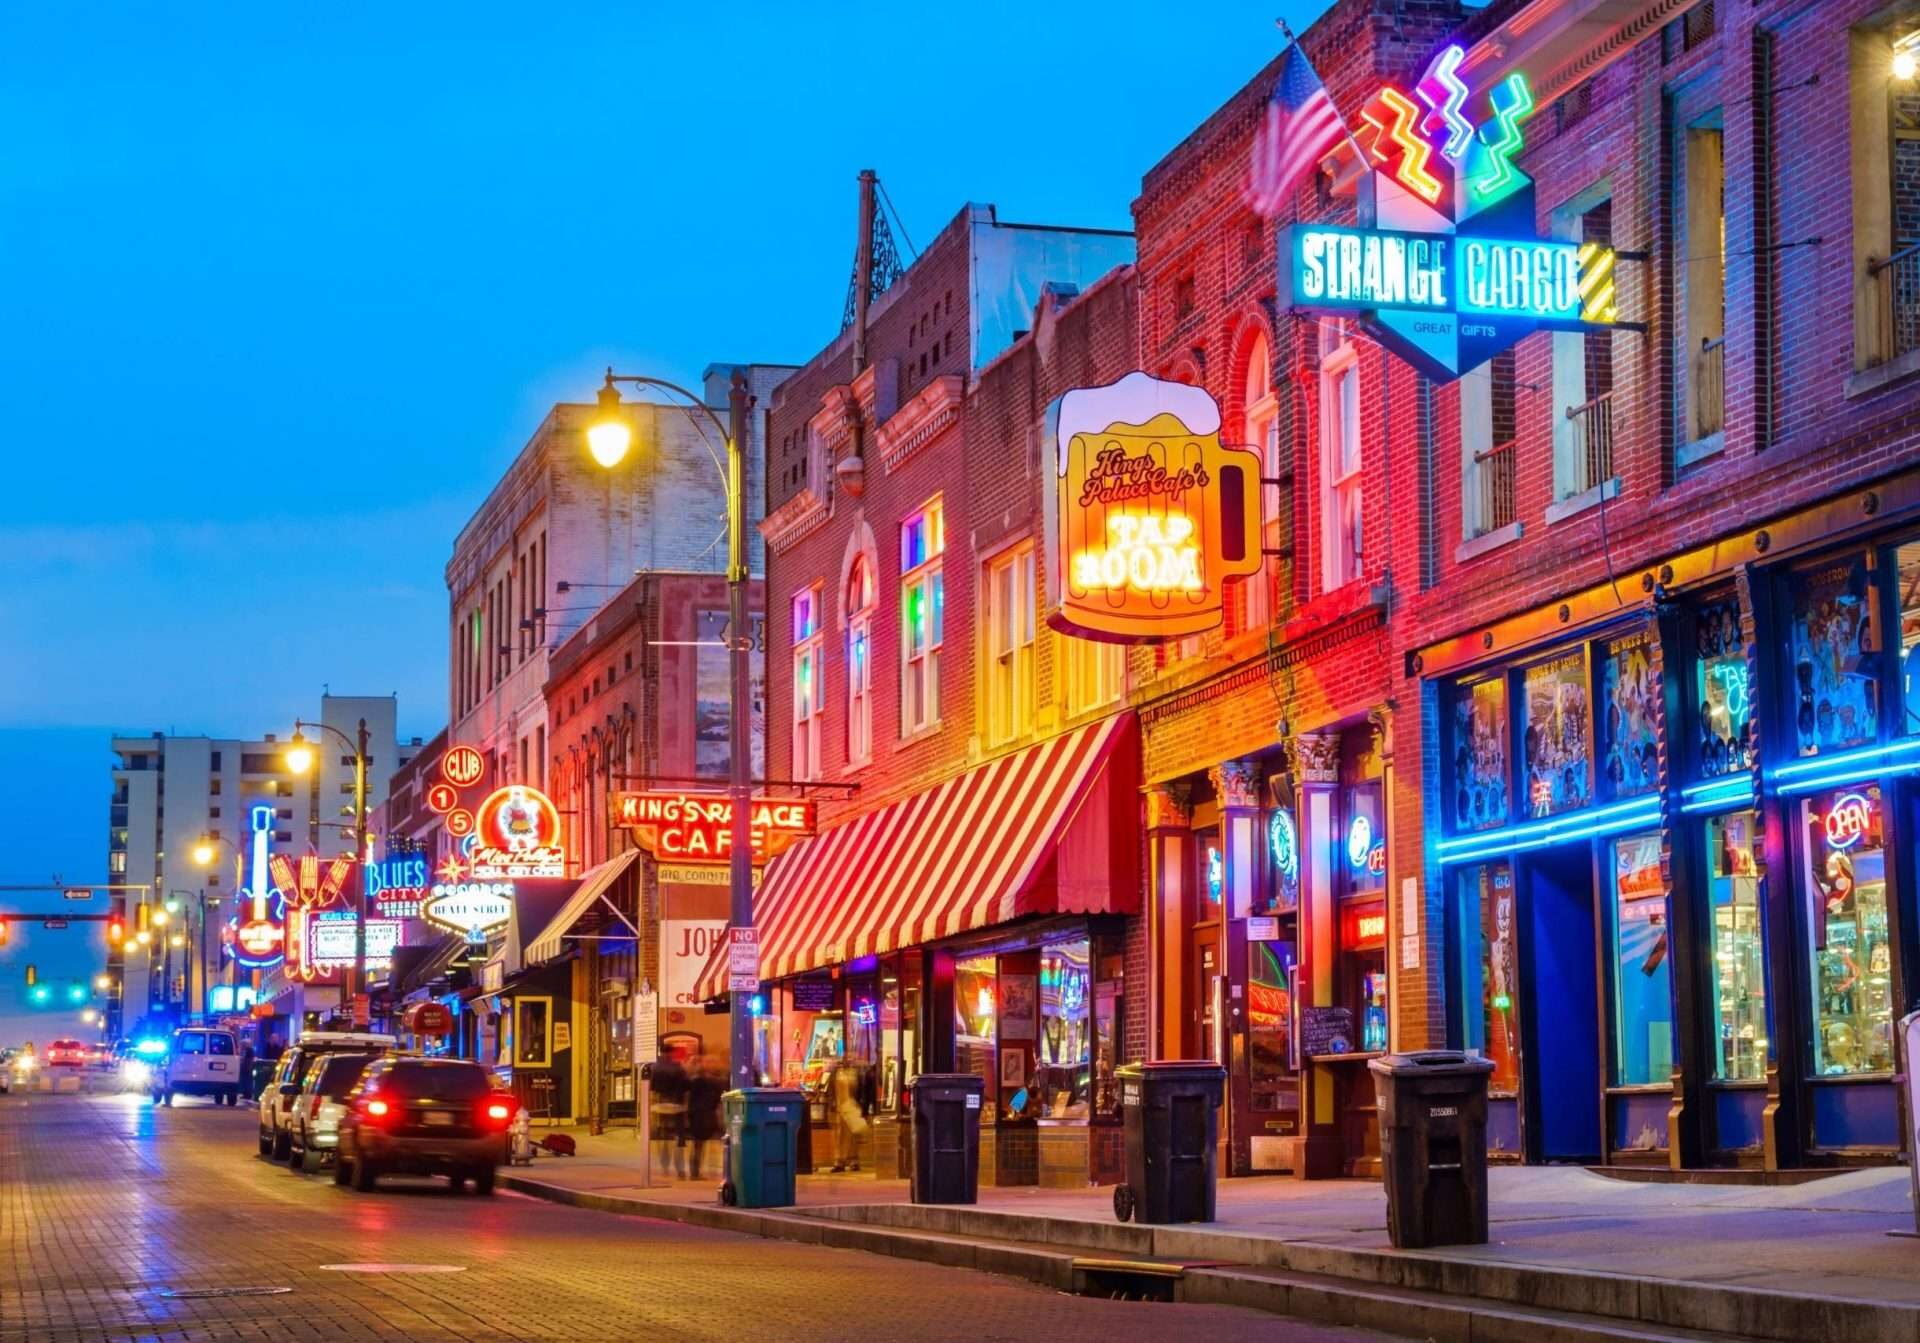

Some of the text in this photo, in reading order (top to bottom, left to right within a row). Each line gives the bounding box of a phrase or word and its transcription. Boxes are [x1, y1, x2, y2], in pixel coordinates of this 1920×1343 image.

[1302, 232, 1576, 313] STRANGE CARGO
[1413, 322, 1496, 337] GREAT GIFTS
[1092, 450, 1154, 484] Kings
[1079, 474, 1149, 507] Palace
[1108, 514, 1194, 549] TAP
[1073, 546, 1203, 589] ROOM
[447, 750, 480, 782] CLUB
[437, 791, 448, 808] 1
[623, 795, 700, 822] KING'S
[453, 814, 468, 832] 5
[1826, 804, 1870, 839] OPEN
[365, 861, 425, 897] BLUES
[378, 888, 426, 901] CITY
[735, 930, 754, 942] NO
